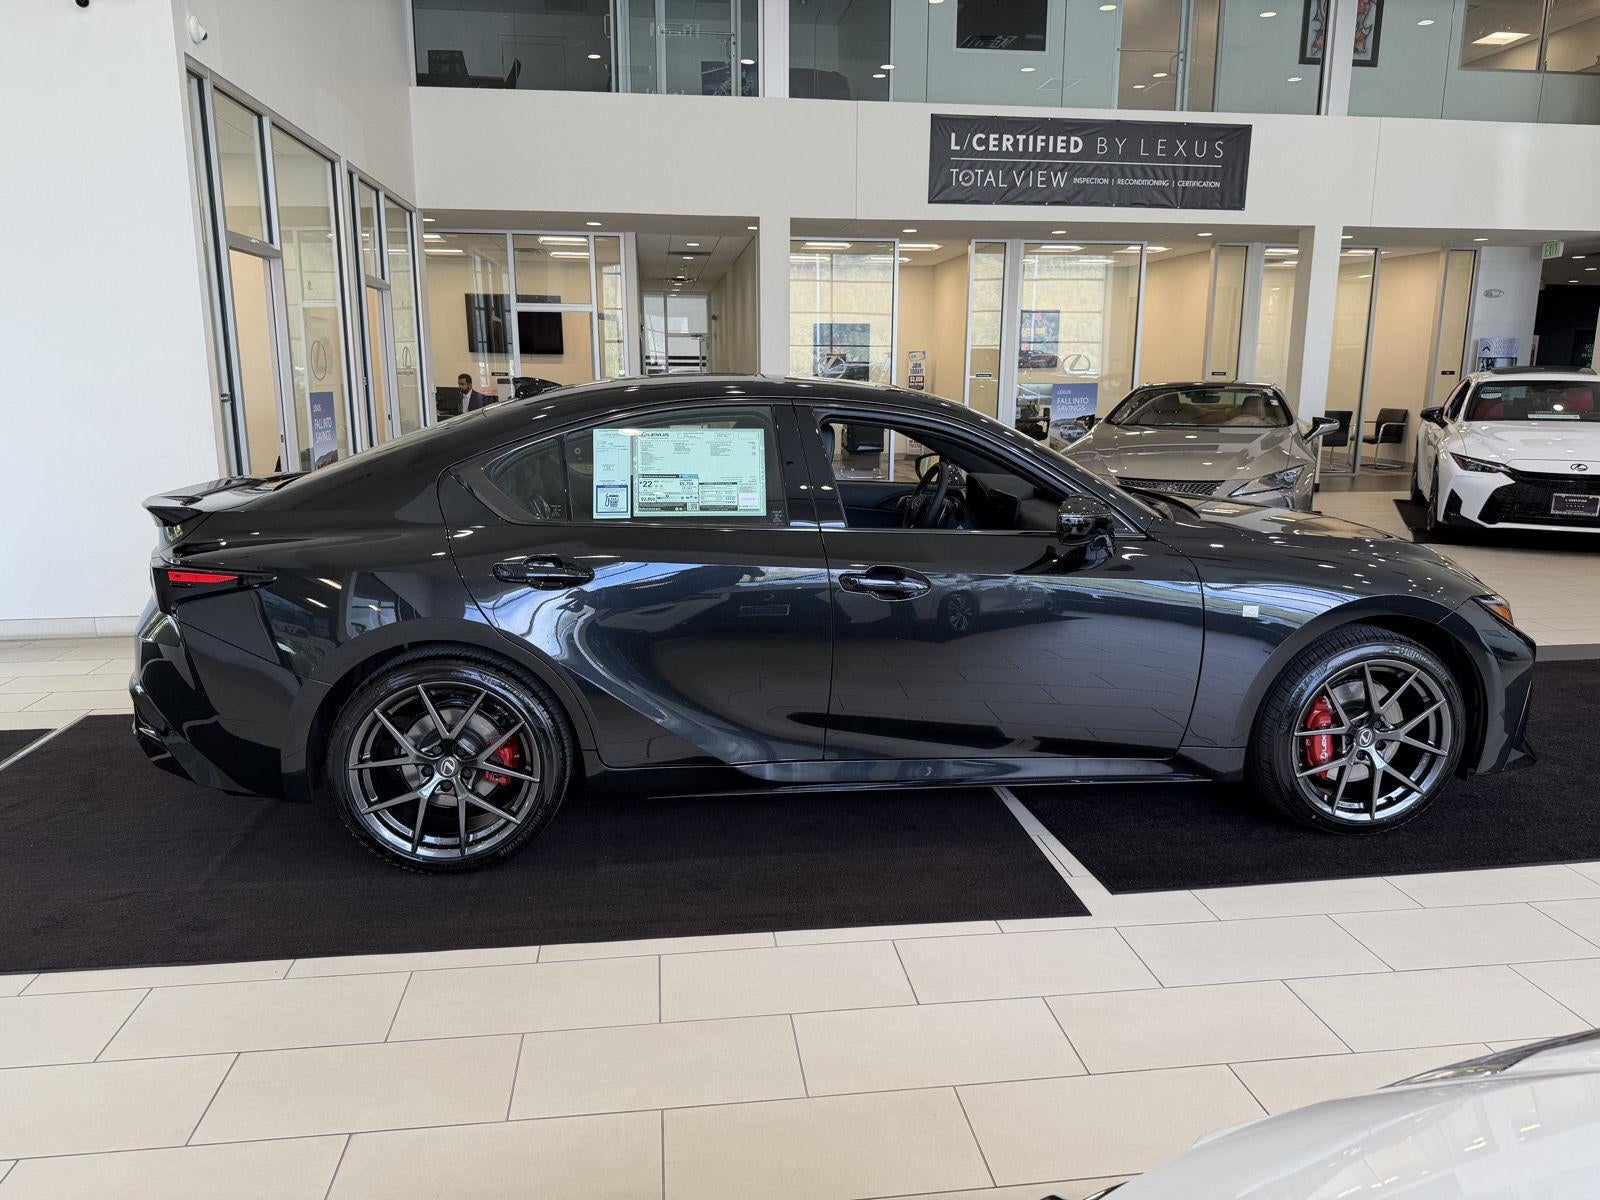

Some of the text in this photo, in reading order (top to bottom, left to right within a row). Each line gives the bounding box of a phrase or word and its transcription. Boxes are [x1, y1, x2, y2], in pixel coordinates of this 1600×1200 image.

[950, 132, 1223, 158] L/CERTIFIED BY LEXUS
[949, 168, 1068, 188] TOTAL VIEW
[1073, 177, 1221, 189] INSPECTION RECONDITIONING CERTIFICATION
[1056, 396, 1089, 405] FALL INTO
[1056, 404, 1086, 412] SAVINGS
[642, 480, 653, 488] 22
